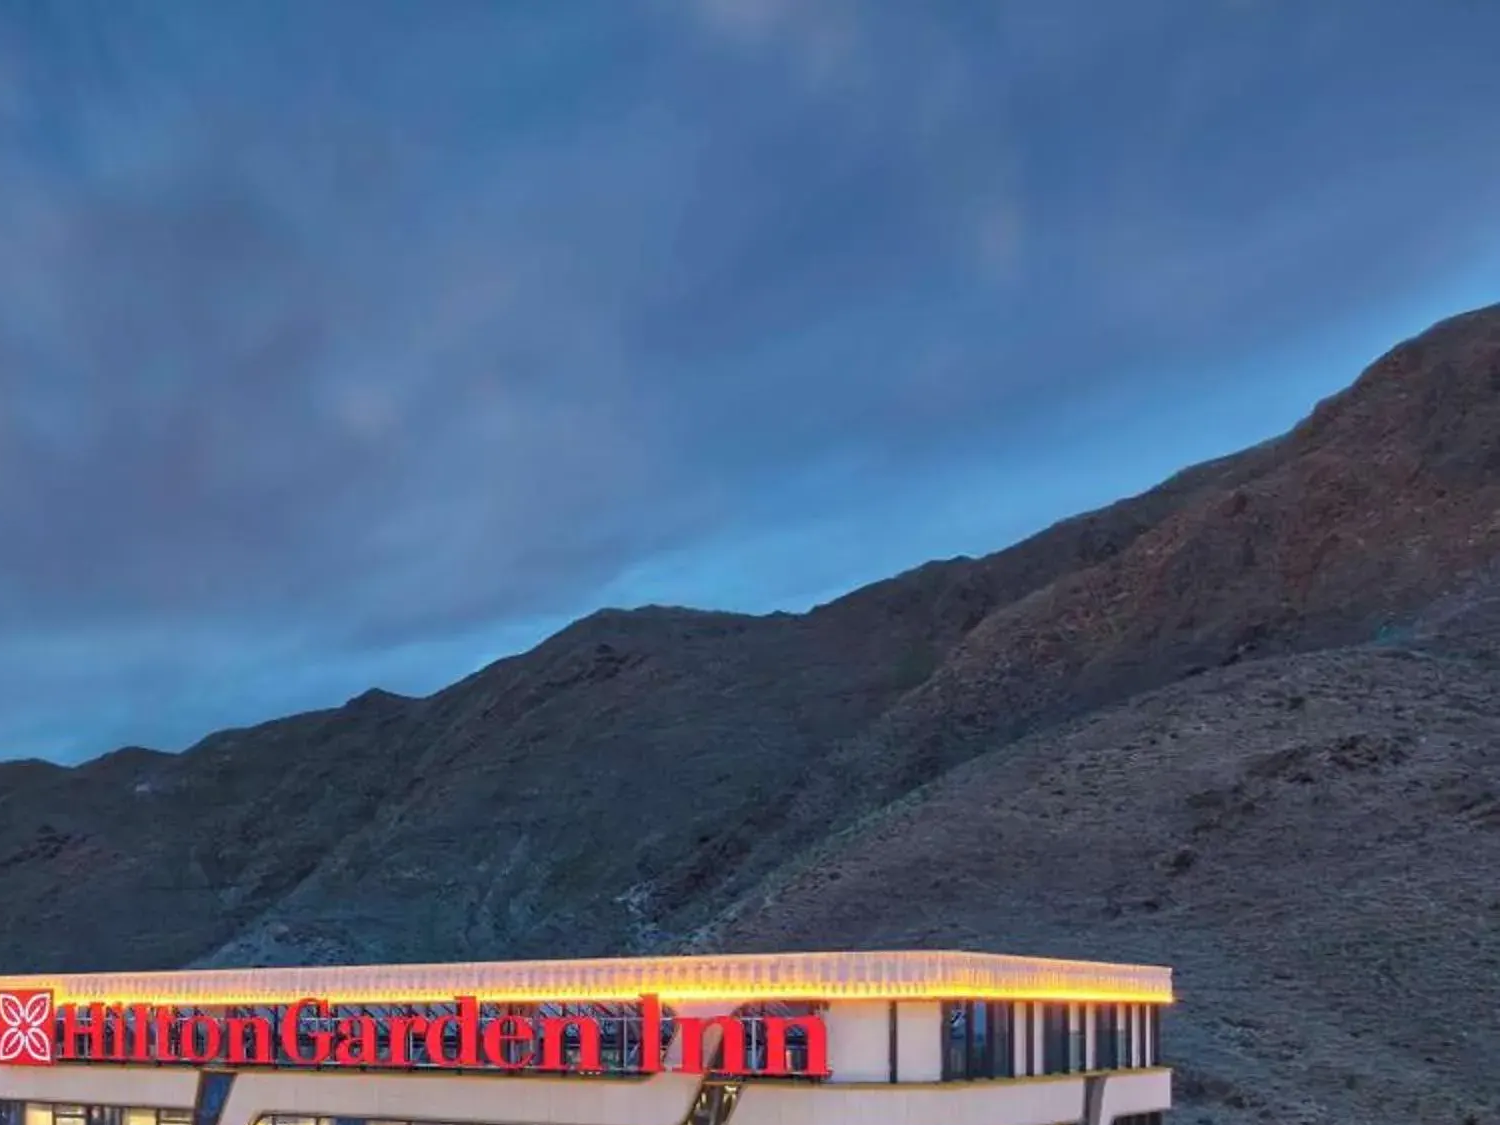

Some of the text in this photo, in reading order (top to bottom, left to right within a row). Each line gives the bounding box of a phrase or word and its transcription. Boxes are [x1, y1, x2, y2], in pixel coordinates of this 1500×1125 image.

[57, 993, 833, 1076] Hilton Garden Inn
